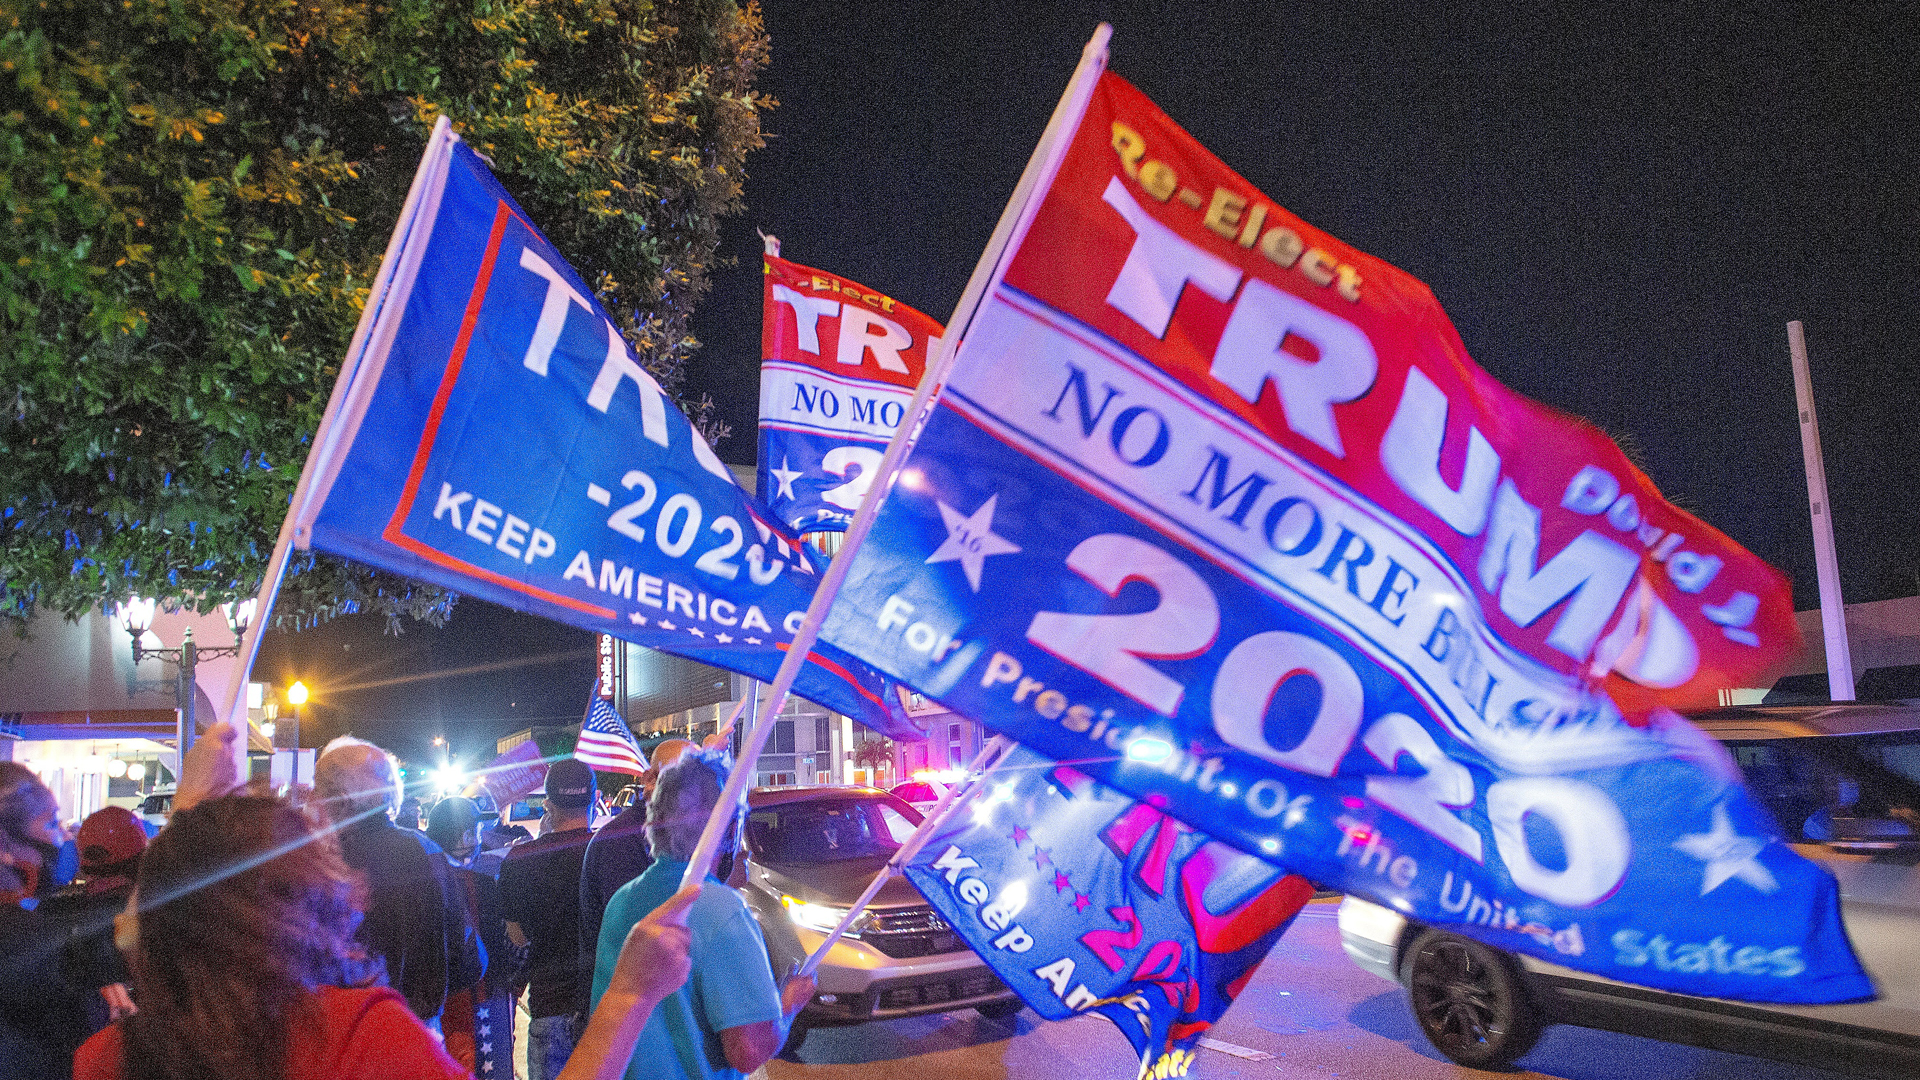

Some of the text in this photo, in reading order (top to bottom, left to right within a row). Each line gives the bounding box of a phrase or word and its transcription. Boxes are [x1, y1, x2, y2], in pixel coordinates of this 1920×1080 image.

[1111, 121, 1364, 301] Re-Elect
[791, 382, 840, 418] NO
[1102, 175, 1699, 690] TRUMP
[433, 482, 556, 565] KEEP
[563, 551, 772, 634] AMERICA
[1041, 363, 1421, 628] NO MORE
[601, 655, 612, 696] Public
[1026, 533, 1633, 908] 2020
[876, 595, 962, 663] For
[1438, 870, 1586, 957] United
[1611, 928, 1806, 979] States
[932, 845, 1034, 954] Keep
